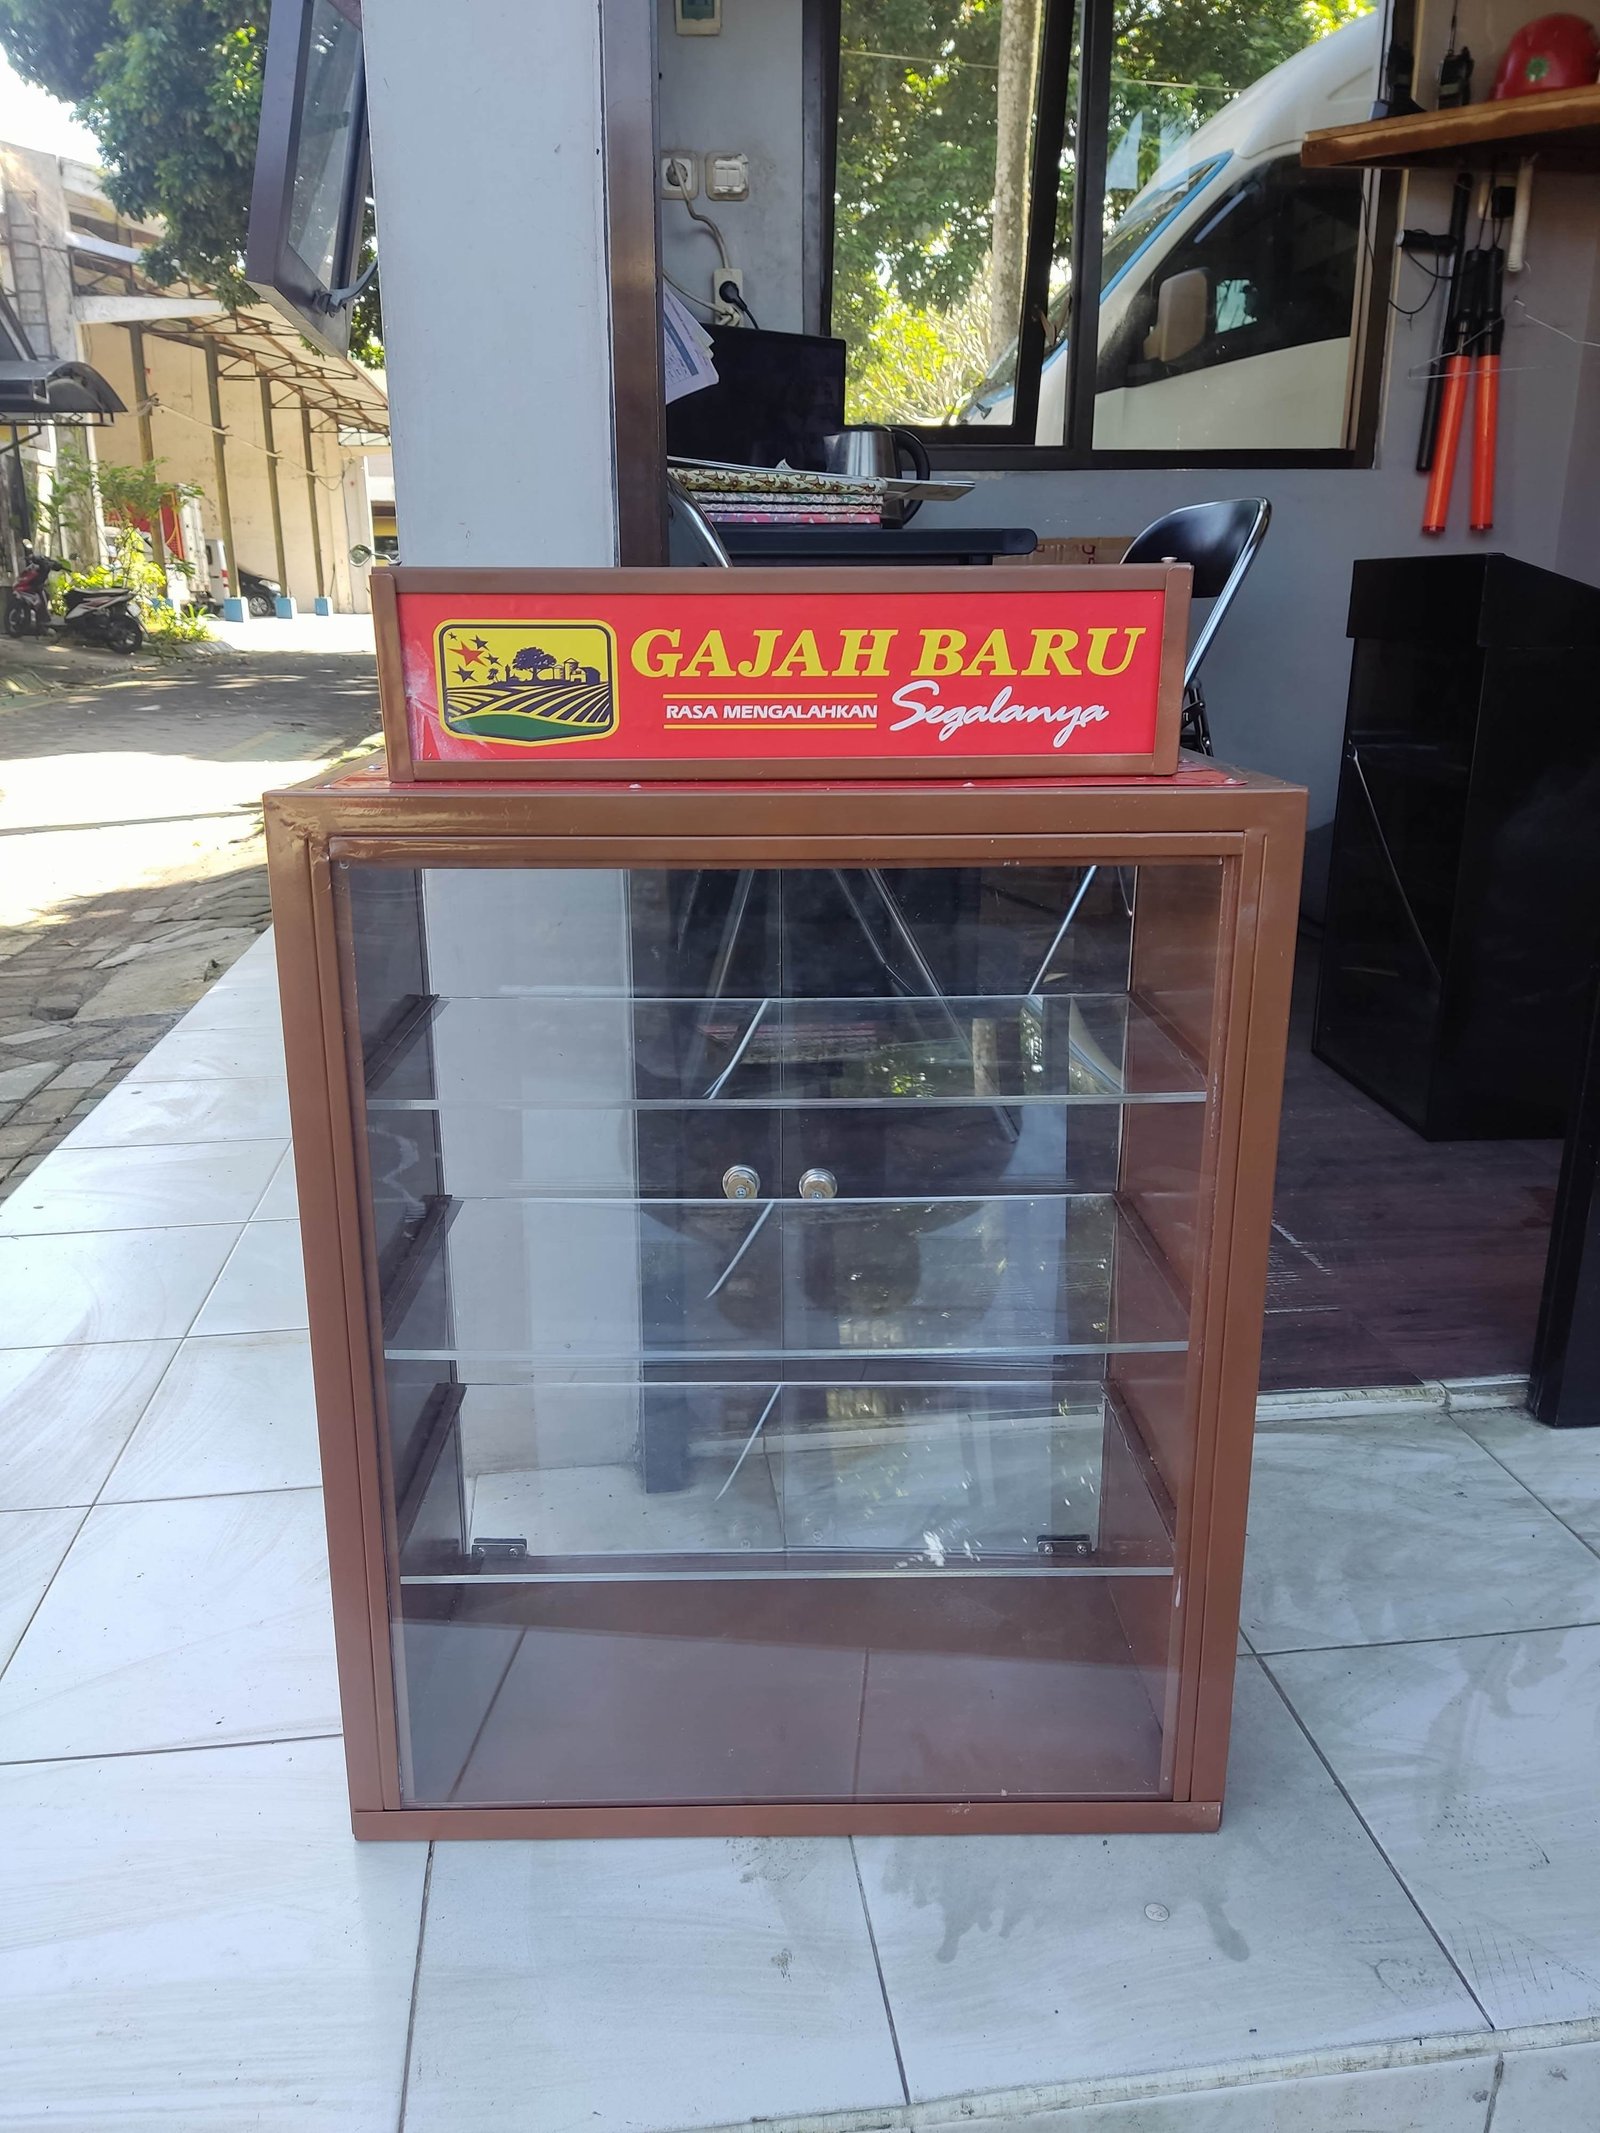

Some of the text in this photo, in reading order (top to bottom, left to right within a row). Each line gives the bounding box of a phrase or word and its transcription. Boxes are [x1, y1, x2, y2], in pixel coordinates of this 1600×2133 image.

[630, 627, 1146, 678] GAJAH BARU
[665, 703, 879, 720] RASA MENGALAHKAN
[889, 679, 1111, 749] Segalanya
